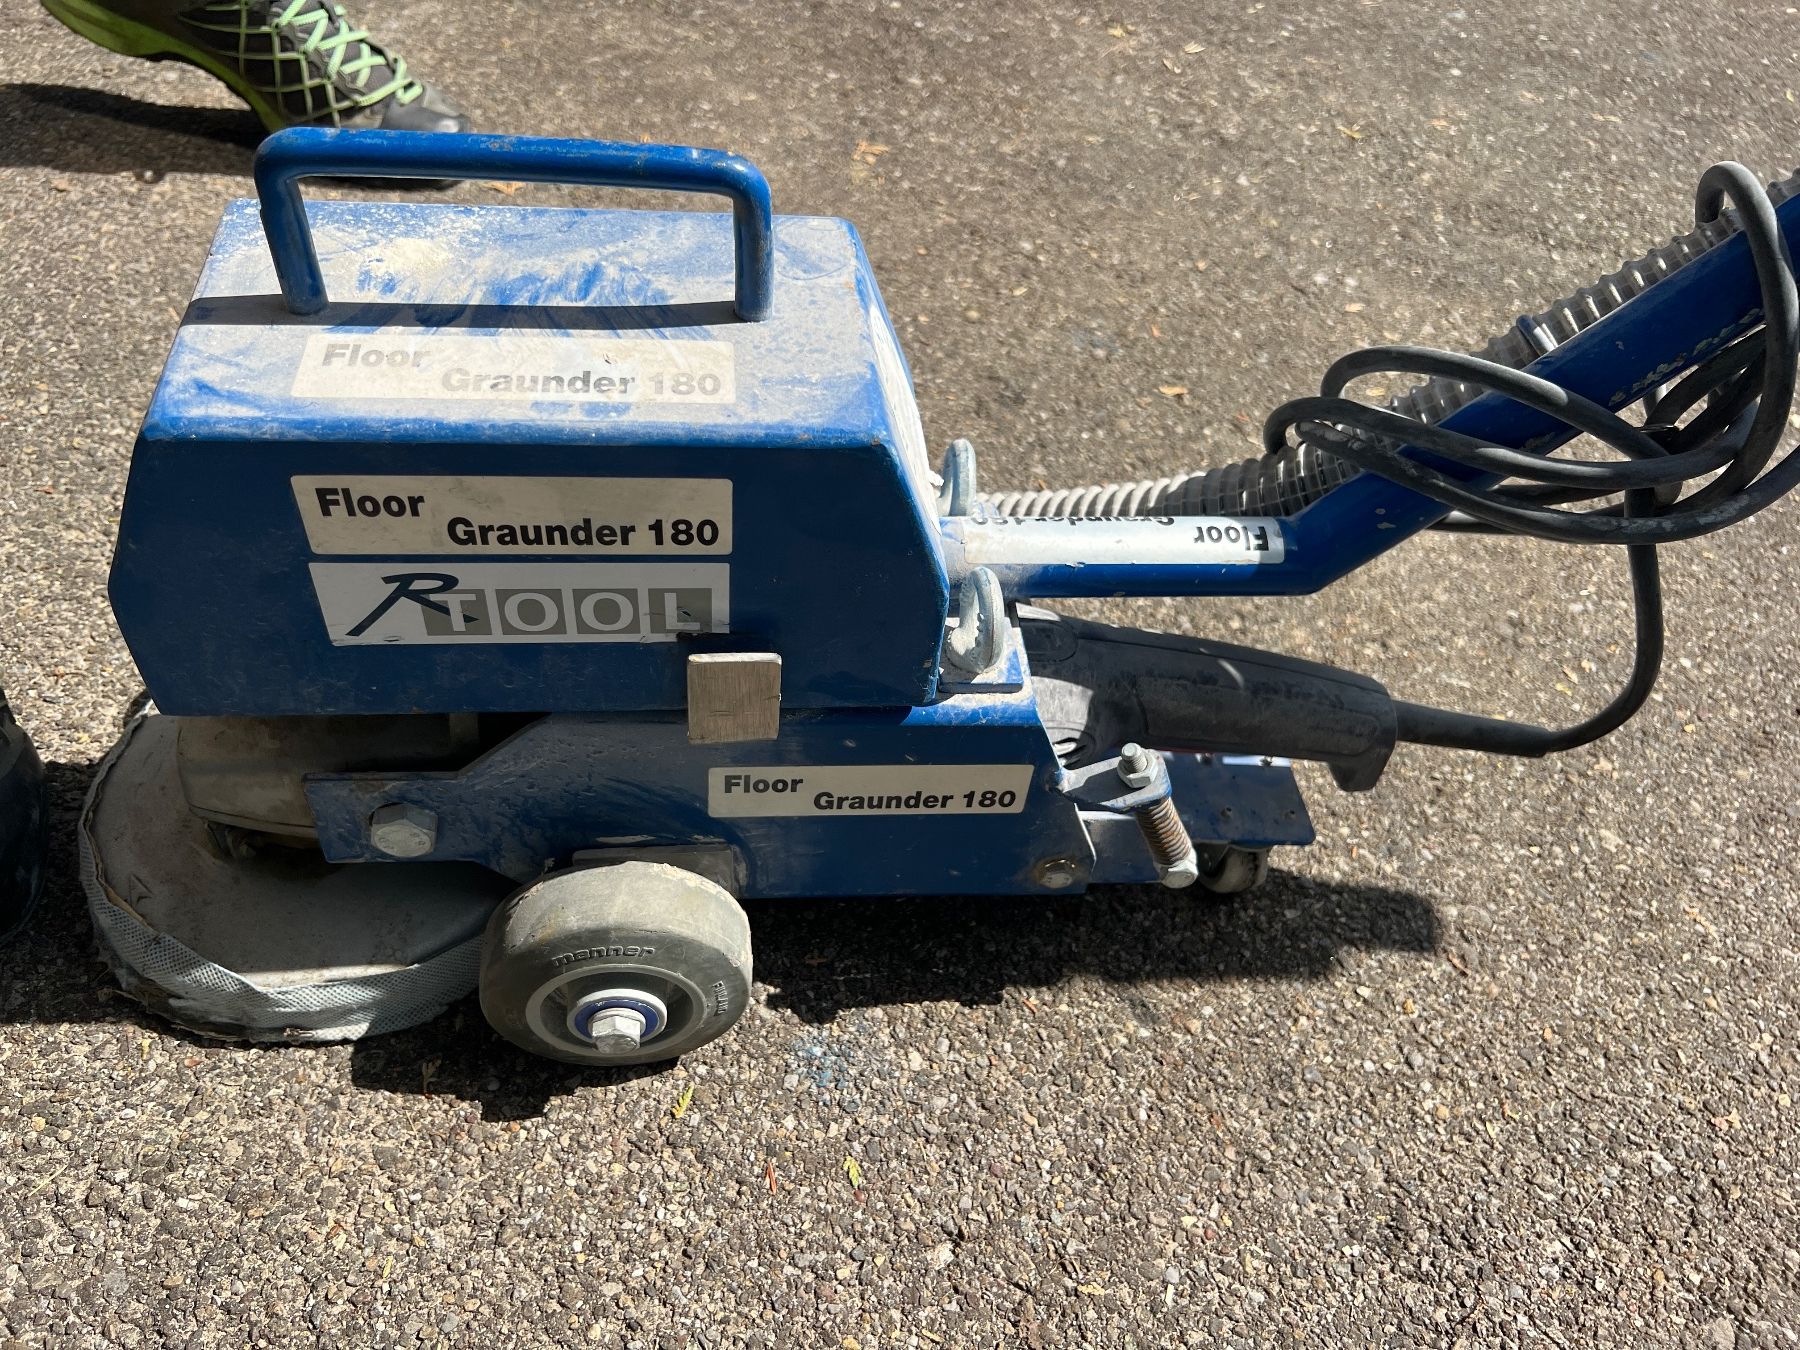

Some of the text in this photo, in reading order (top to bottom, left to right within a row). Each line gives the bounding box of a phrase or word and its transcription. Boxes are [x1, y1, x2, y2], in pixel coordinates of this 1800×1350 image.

[321, 343, 431, 368] Floor
[442, 368, 722, 396] Graunder 180
[314, 487, 425, 517] Floor
[446, 517, 719, 546] Graunder 180
[1193, 525, 1270, 551] Floor
[724, 774, 804, 793] Floor
[812, 790, 1017, 810] Graunder 180
[551, 945, 656, 969] manner
